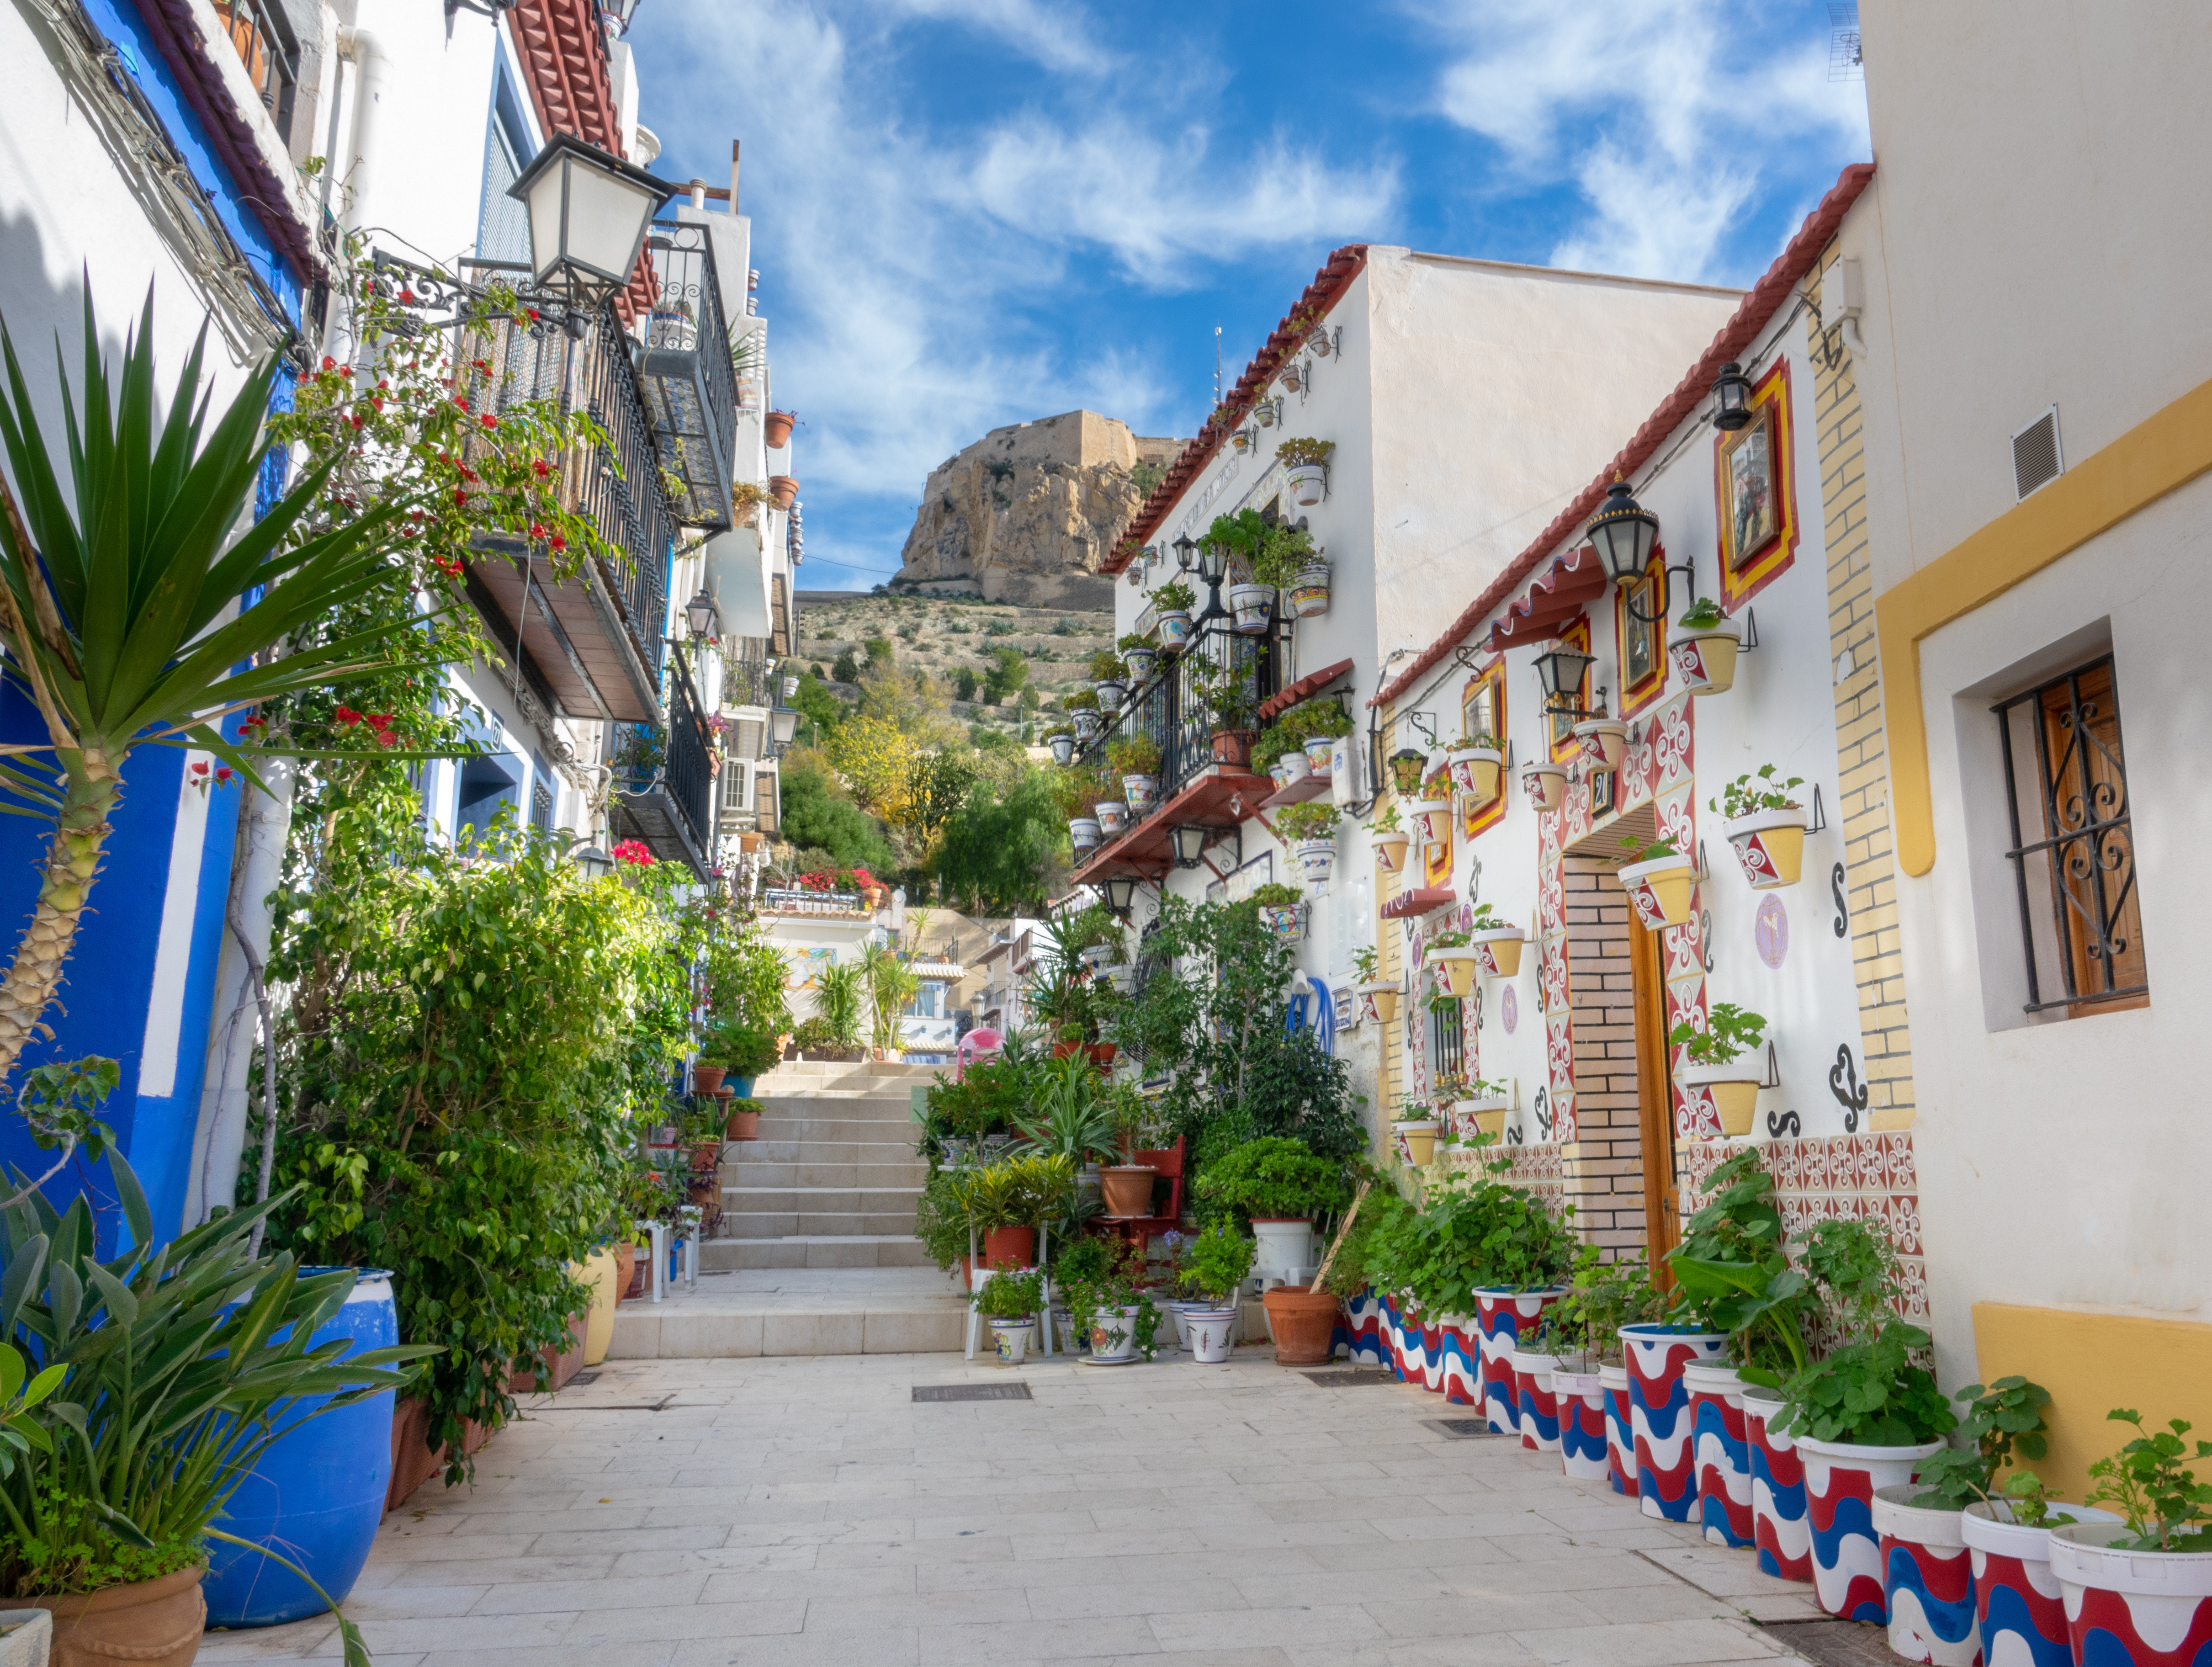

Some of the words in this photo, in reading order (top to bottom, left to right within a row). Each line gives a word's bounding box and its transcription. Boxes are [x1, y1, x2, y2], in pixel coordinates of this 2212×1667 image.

[1193, 504, 1199, 524] LA
[1201, 484, 1213, 511] YAYA
[1216, 457, 1236, 492] CONCHA
